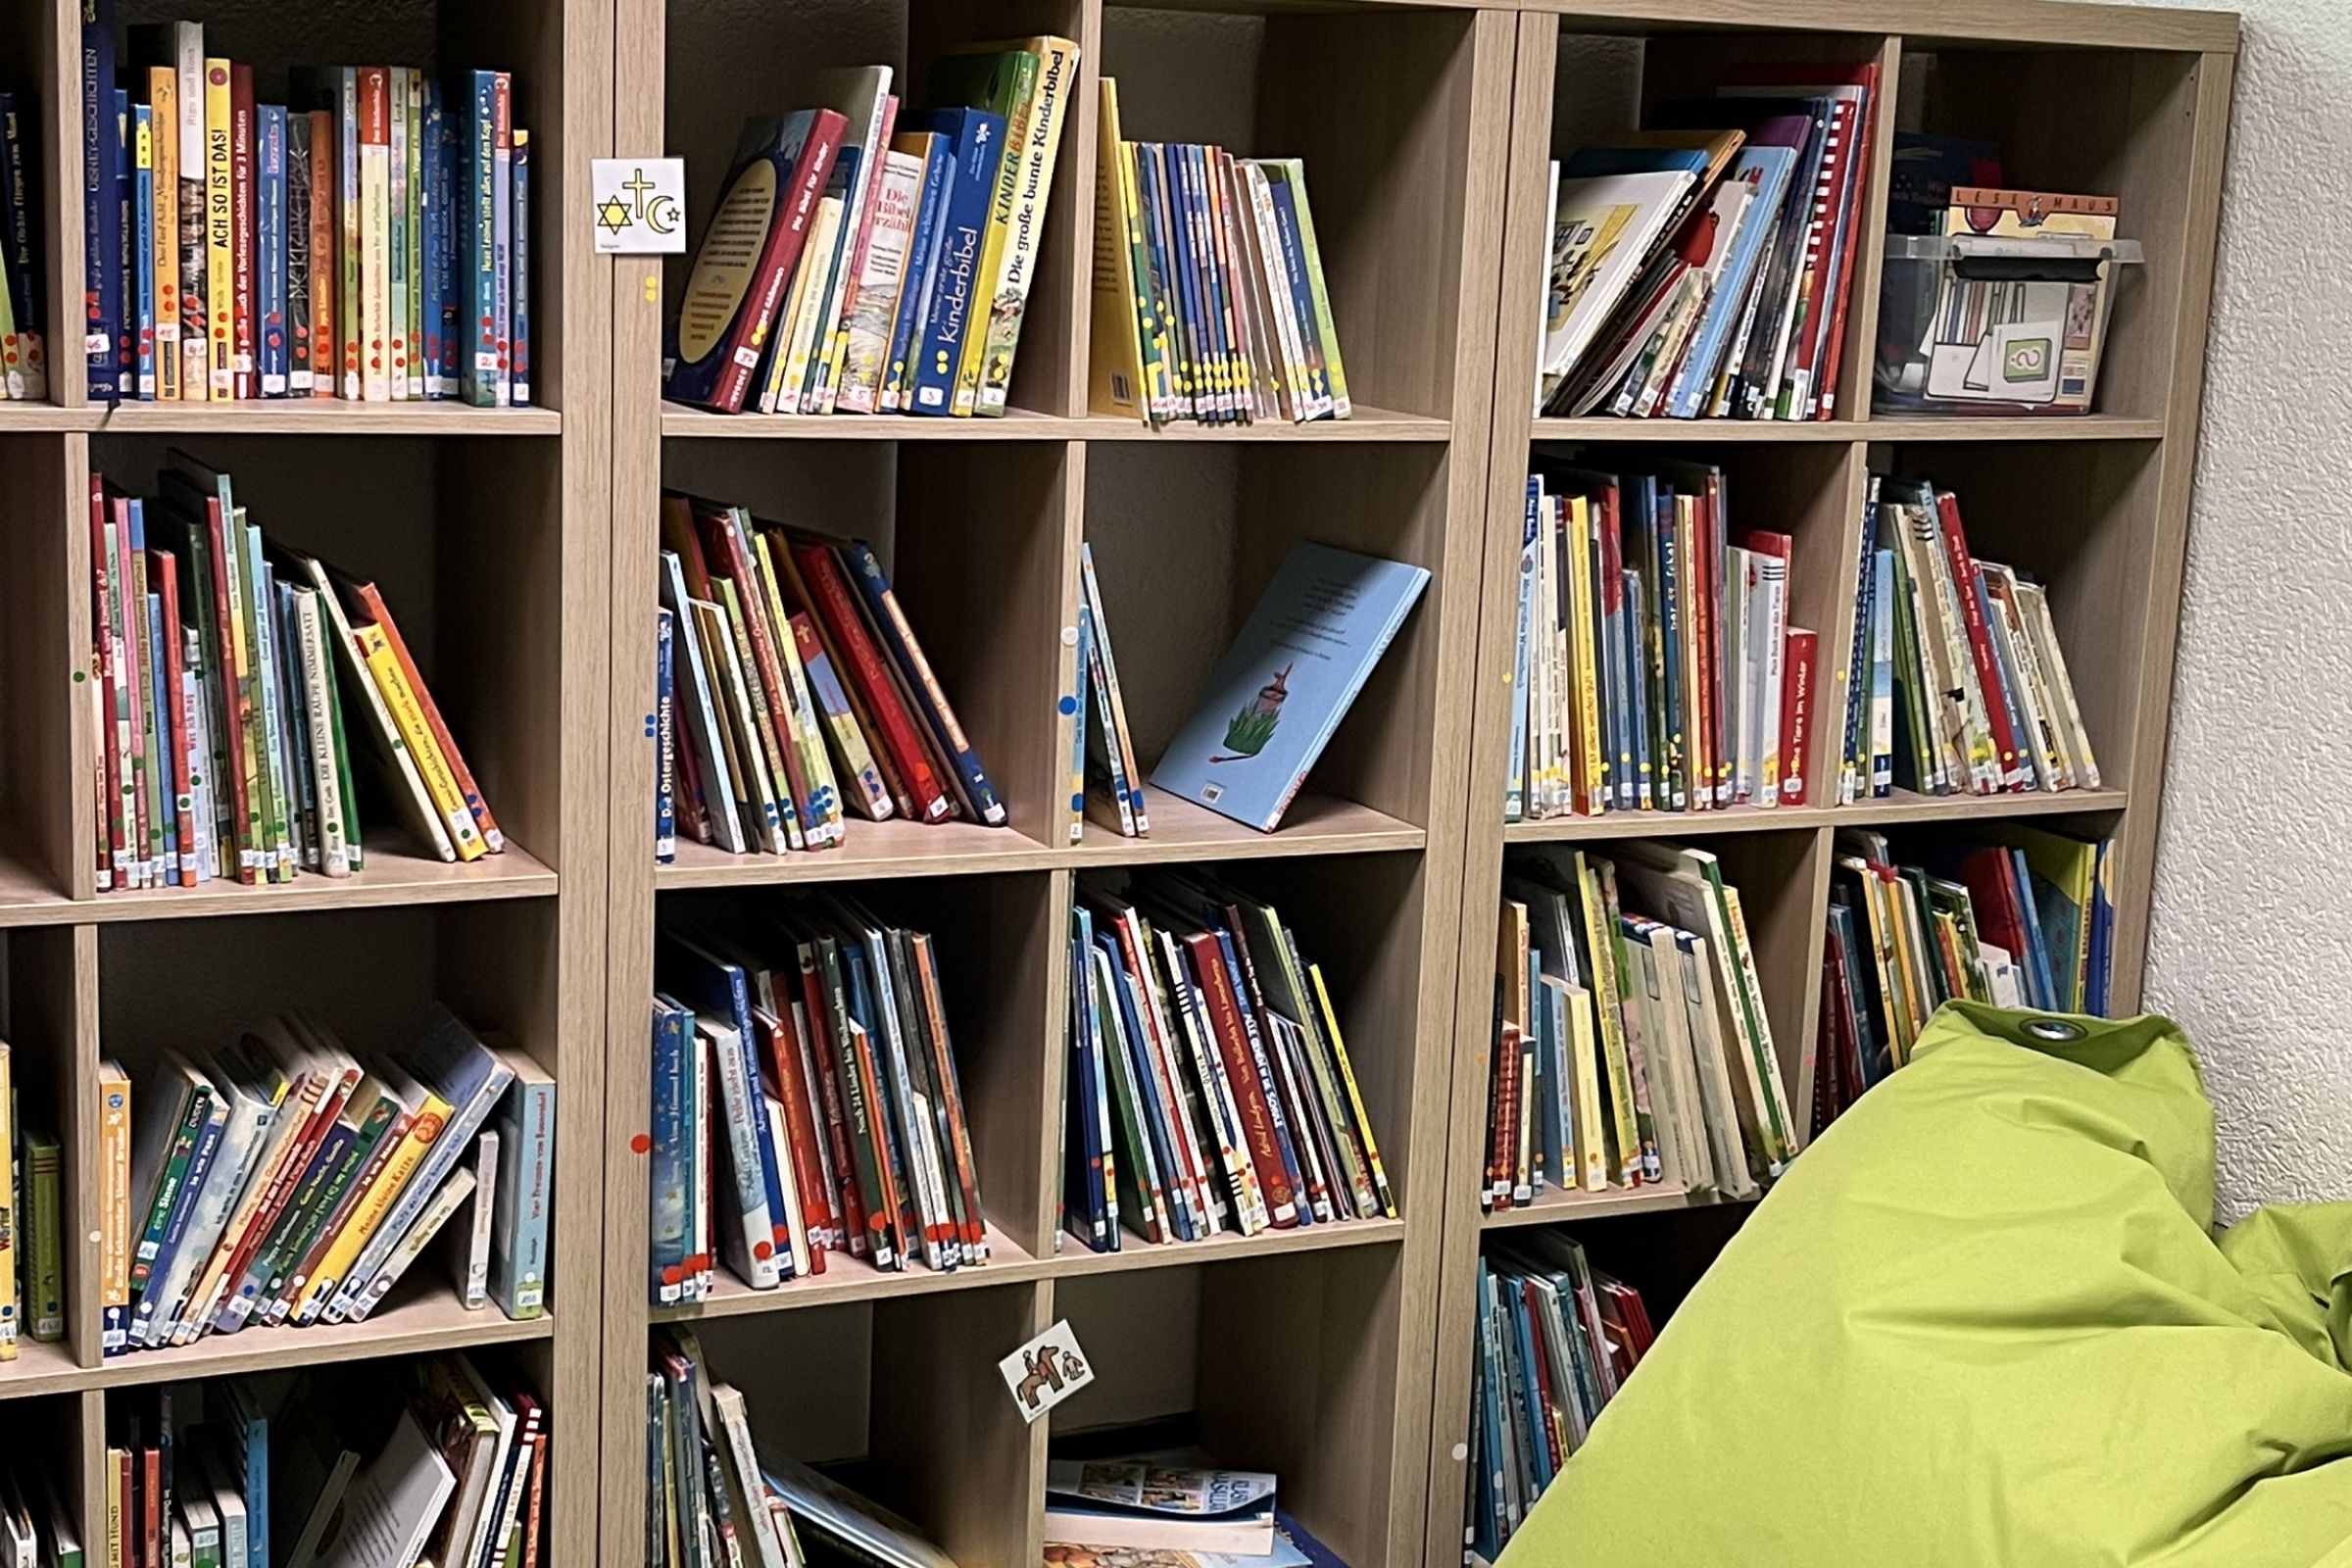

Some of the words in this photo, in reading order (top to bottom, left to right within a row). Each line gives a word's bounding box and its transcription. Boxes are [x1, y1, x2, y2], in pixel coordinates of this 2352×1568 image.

[184, 76, 196, 97] und
[1031, 48, 1064, 147] Kinderbibel
[235, 110, 246, 153] Minuten
[479, 119, 493, 139] Kopf
[212, 128, 226, 162] DAS!
[479, 141, 491, 158] den
[810, 140, 830, 172] Kinder
[236, 165, 246, 178] für
[479, 158, 491, 173] auf
[992, 97, 1032, 225] KINDERBIBEL
[212, 168, 226, 188] IST
[479, 174, 492, 195] alles
[805, 171, 818, 188] für
[1021, 150, 1044, 200] bunte
[213, 193, 227, 213] SO
[480, 196, 492, 218] stellt
[796, 189, 812, 214] Bibel
[885, 187, 908, 203] Die
[1955, 189, 2018, 205] LESE
[2053, 197, 2113, 213] MAUS
[790, 214, 804, 231] Die
[877, 201, 910, 220] Bibel
[212, 219, 227, 247] ACH
[236, 180, 249, 272] Vorlesegeschichten
[1011, 201, 1037, 251] große
[481, 249, 492, 271] Hexe
[1005, 253, 1025, 284] Die
[237, 275, 247, 290] der
[938, 227, 979, 343] Kinderbibel
[96, 567, 108, 586] du?
[97, 589, 110, 626] kommst
[136, 599, 147, 639] kommt
[300, 610, 318, 680] NIMMERSATT
[1796, 661, 1807, 698] Winter
[309, 682, 322, 718] RAUPE
[1585, 695, 1594, 727] wieder
[1794, 699, 1804, 714] im
[186, 715, 195, 729] ich
[1792, 716, 1803, 744] Tiere
[314, 719, 328, 760] KLEINE
[659, 696, 672, 793] Ostergeschichte
[1587, 727, 1596, 751] alles
[318, 761, 330, 780] DIE
[831, 985, 852, 1048] Weihnachten
[669, 1049, 679, 1073] hoch
[725, 1047, 736, 1067] aus
[843, 1048, 854, 1062] bis
[725, 1068, 740, 1096] zieht
[1243, 1010, 1259, 1036] ALLE
[1265, 1090, 1284, 1128] SCHULE
[749, 1075, 760, 1095] und
[186, 1095, 206, 1128] DUDEN
[852, 1095, 862, 1106] 24
[854, 1107, 867, 1134] Noch
[193, 1155, 206, 1175] wie
[156, 1175, 177, 1209] Sinne
[357, 1207, 379, 1235] Meine
[373, 1180, 398, 1210] kleine
[390, 1153, 415, 1183] Katze
[108, 1504, 119, 1539] HUND
